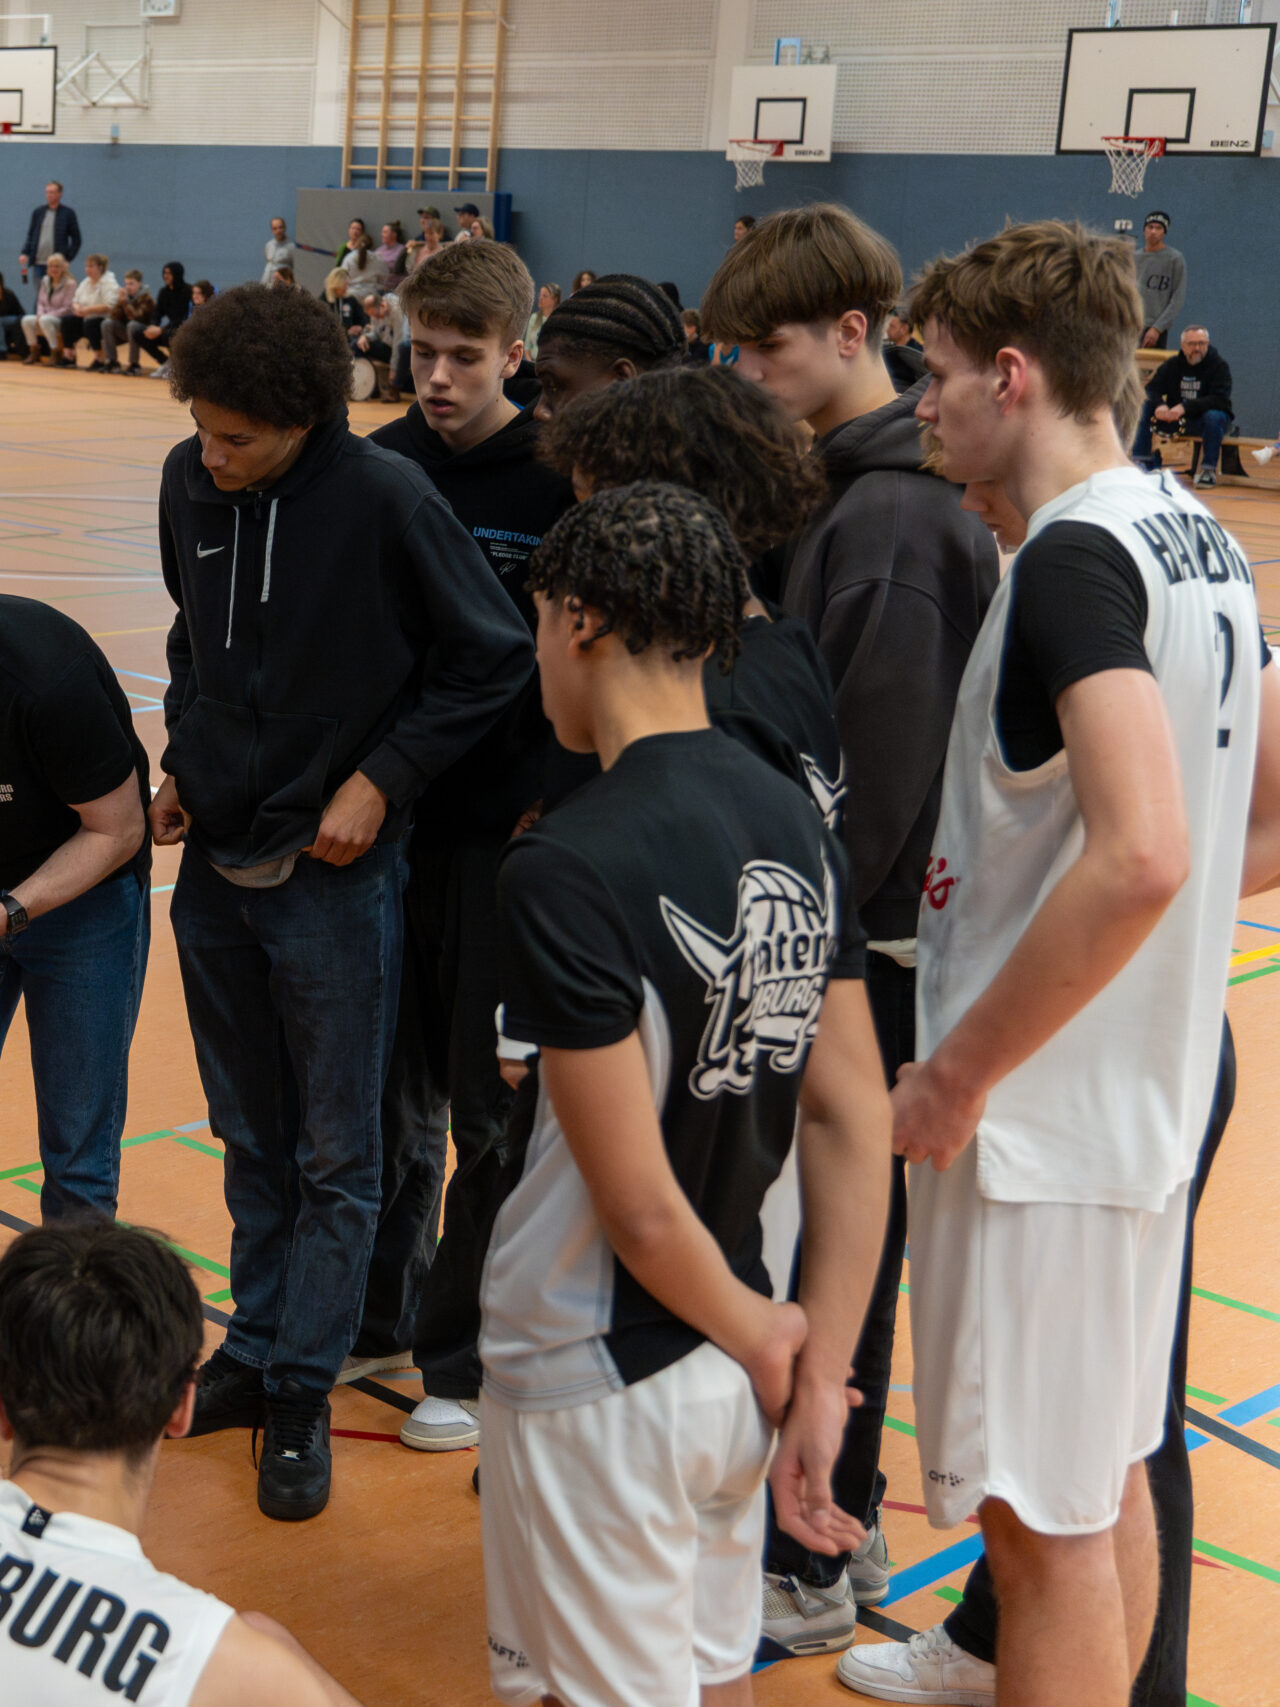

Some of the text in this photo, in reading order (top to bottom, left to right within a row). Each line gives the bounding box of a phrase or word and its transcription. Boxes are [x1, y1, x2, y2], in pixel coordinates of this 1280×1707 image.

[1210, 140, 1250, 148] BENZ
[1147, 274, 1171, 291] CB
[473, 526, 544, 546] UNDERTAKIN
